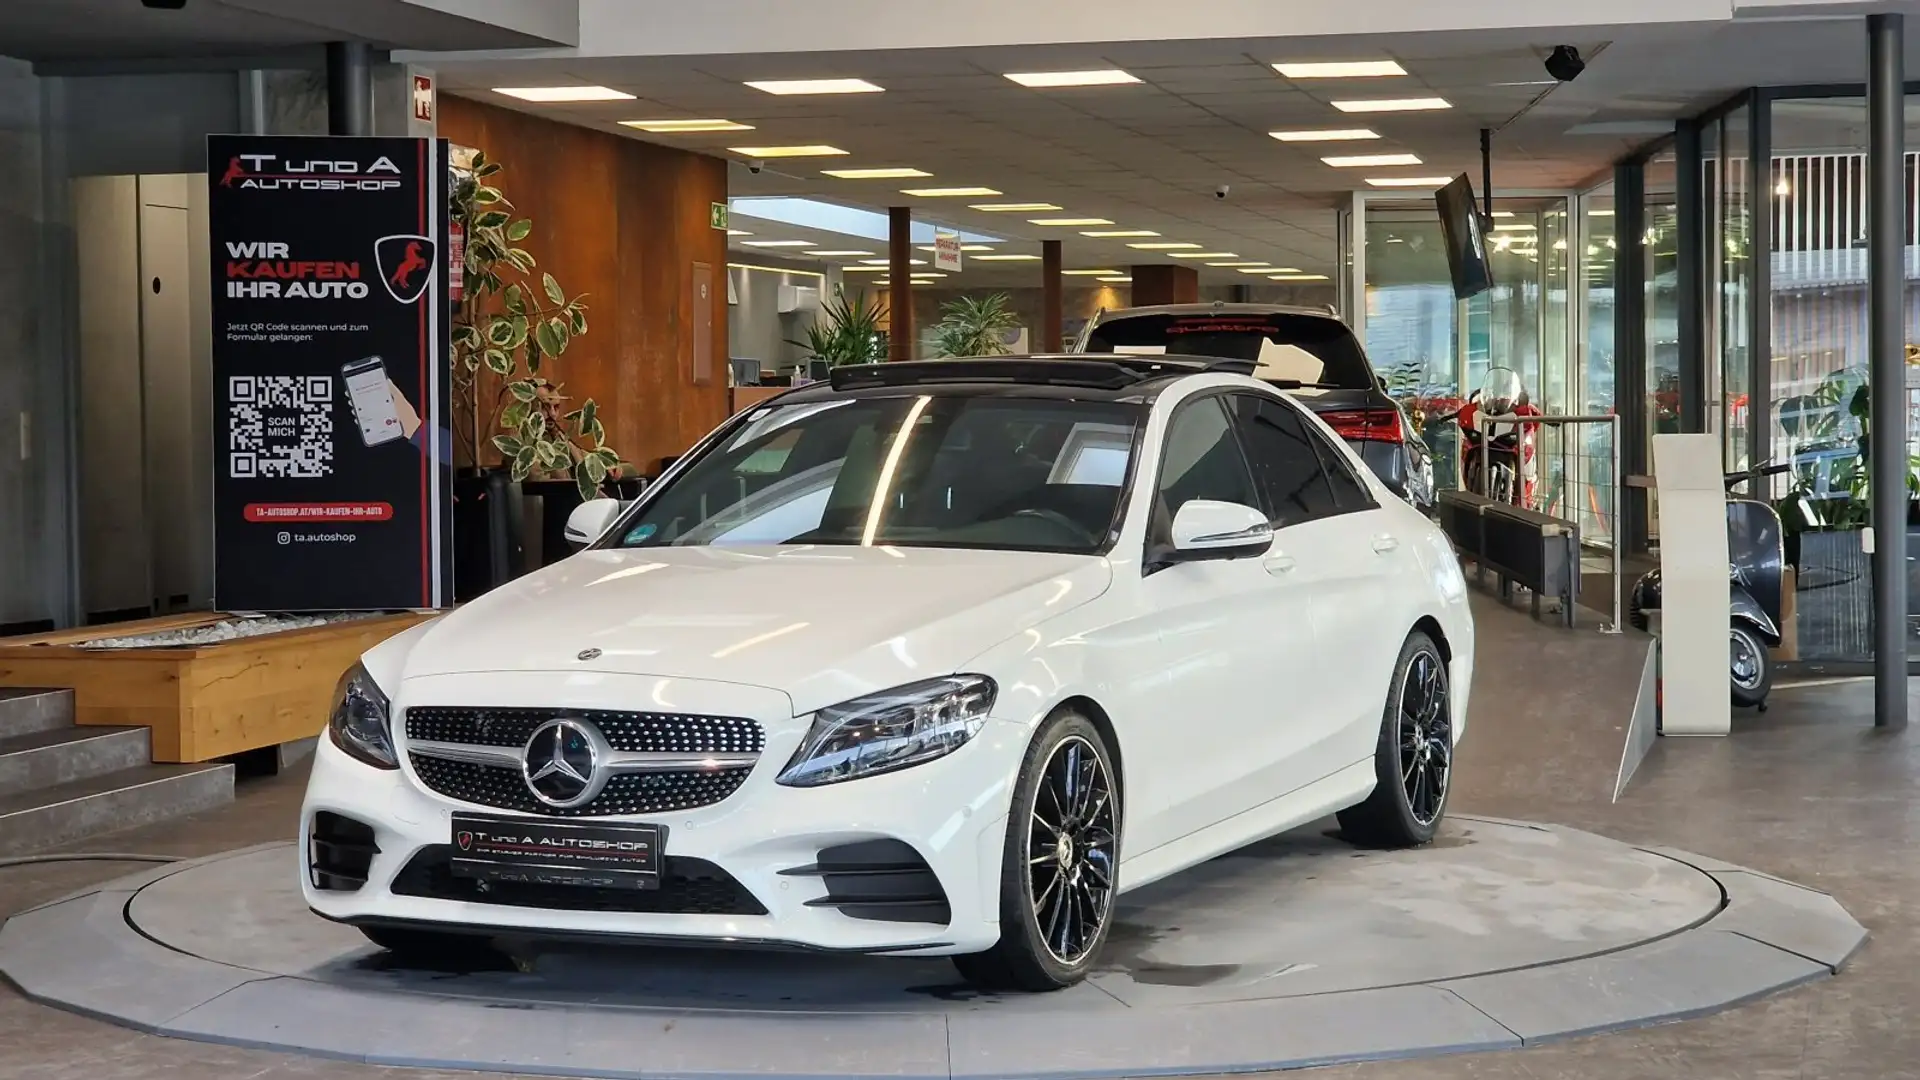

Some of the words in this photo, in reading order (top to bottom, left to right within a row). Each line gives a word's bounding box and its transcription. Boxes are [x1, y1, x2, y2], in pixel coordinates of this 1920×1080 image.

[240, 154, 276, 172] T
[366, 156, 401, 174] A
[240, 179, 401, 191] AUTOSHOP
[226, 242, 289, 259] WIR
[227, 262, 359, 279] KAUFEN
[227, 282, 280, 298] IHR
[284, 282, 369, 299] AUTO
[227, 323, 248, 331] Jetzt
[250, 323, 264, 332] QR
[266, 323, 289, 331] Code
[329, 323, 347, 331] und
[1166, 325, 1279, 333] quattro
[227, 333, 267, 341] Formular
[269, 333, 313, 342] gelangen:
[267, 417, 295, 426] SCAN
[267, 427, 295, 437] MICH
[256, 507, 383, 516] TA-AUTOSHOP.AT/WIR-KAUFEN-IHR-AUTO
[294, 533, 356, 543] ta.autoshop
[475, 832, 487, 840] T
[521, 836, 534, 844] A
[539, 837, 648, 850] AUTOSHOP
